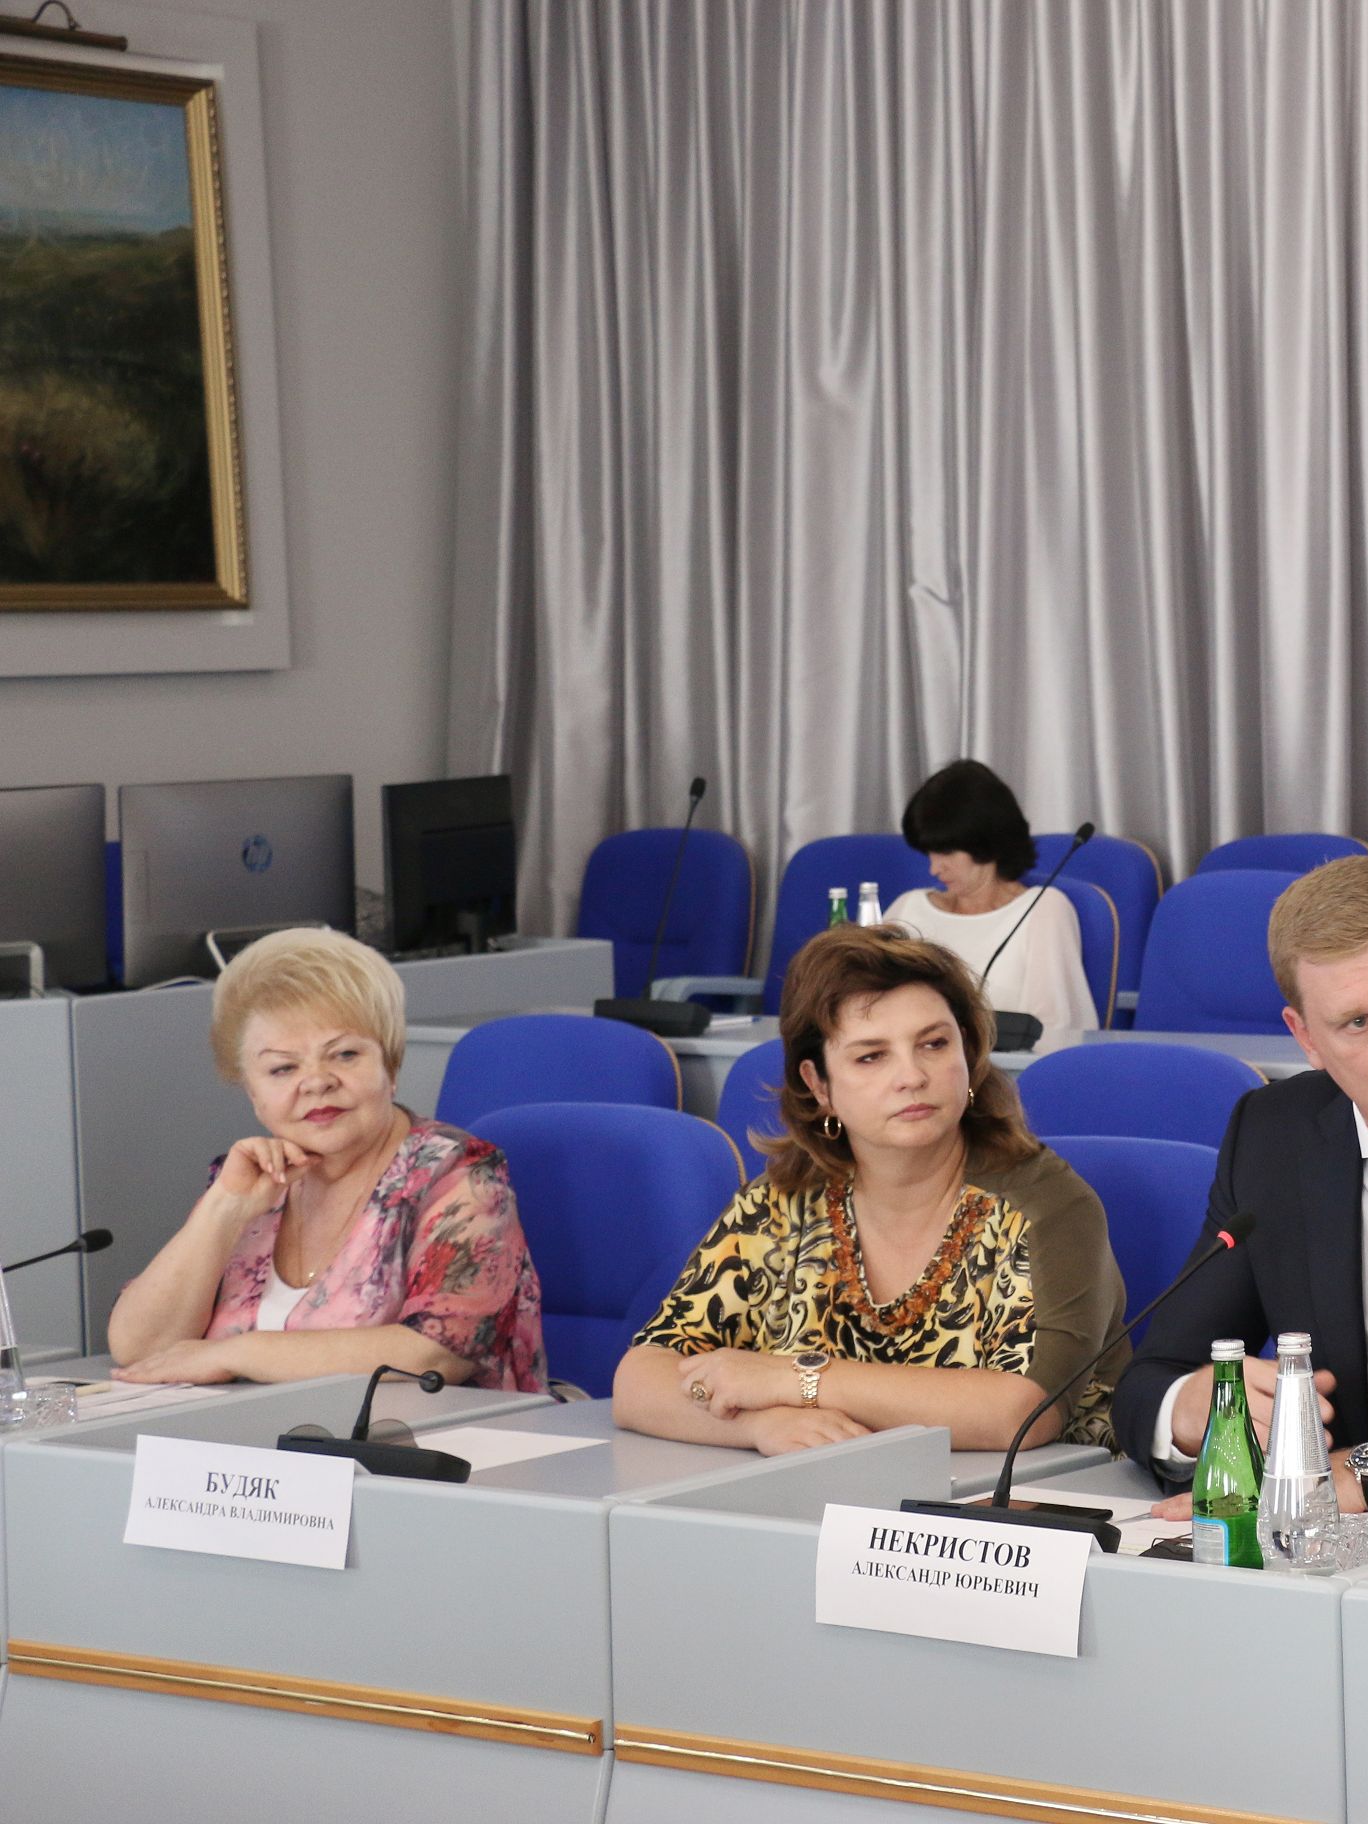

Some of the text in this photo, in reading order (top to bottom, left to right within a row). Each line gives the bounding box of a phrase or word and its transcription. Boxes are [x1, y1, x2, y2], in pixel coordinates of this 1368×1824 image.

[206, 1471, 280, 1500] БУДЯК
[145, 1497, 335, 1530] АЛЕКСАНДРА ВЛАДИМИРОВНА
[869, 1527, 1032, 1568] НЕКРИСТОВ
[851, 1560, 1039, 1598] АЛЕКСАНДР ЮРЬЕВИЧ
